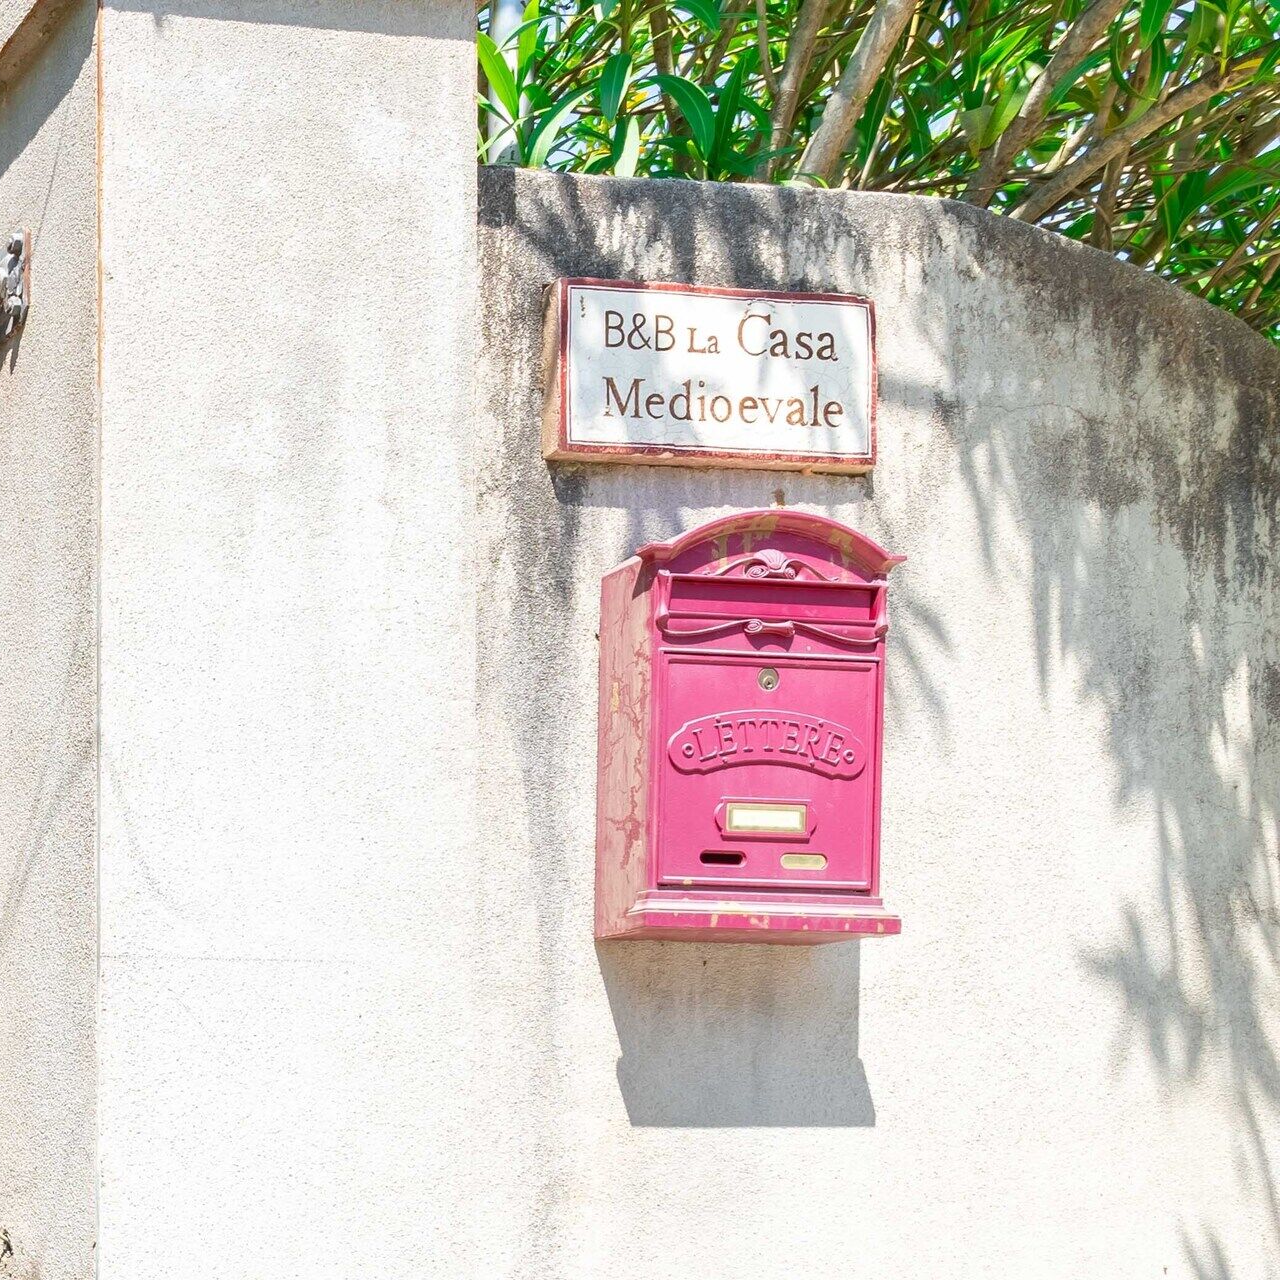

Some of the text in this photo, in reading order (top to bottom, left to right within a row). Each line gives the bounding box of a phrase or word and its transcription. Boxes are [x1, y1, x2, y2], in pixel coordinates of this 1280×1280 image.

[604, 310, 839, 361] B&B La Casa
[602, 376, 843, 427] Medioevale
[692, 718, 845, 767] LETTERE
